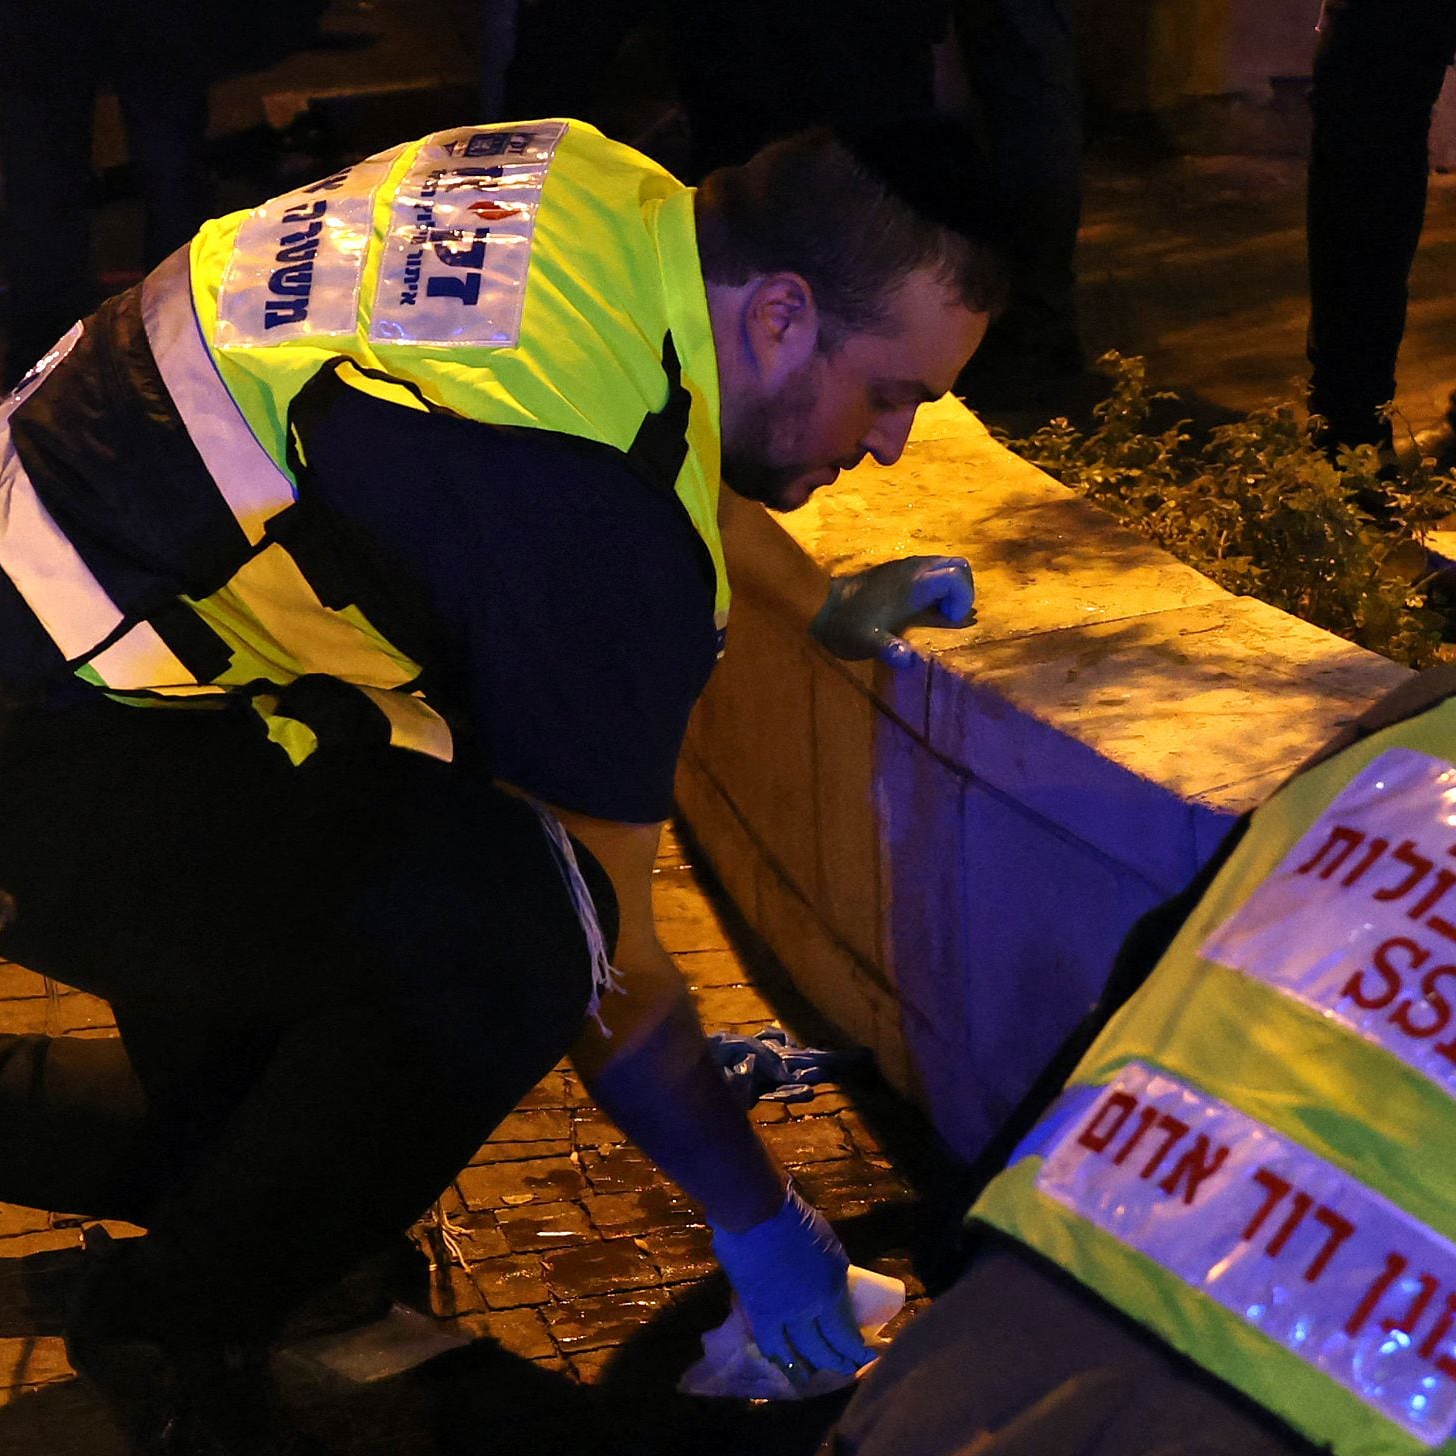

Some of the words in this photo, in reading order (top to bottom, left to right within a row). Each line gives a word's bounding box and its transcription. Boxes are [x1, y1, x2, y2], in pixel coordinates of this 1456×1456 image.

[265, 199, 327, 329] משטרה
[400, 249, 424, 305] איתור
[1076, 1089, 1230, 1205] אדום
[1240, 1166, 1355, 1283] דוד
